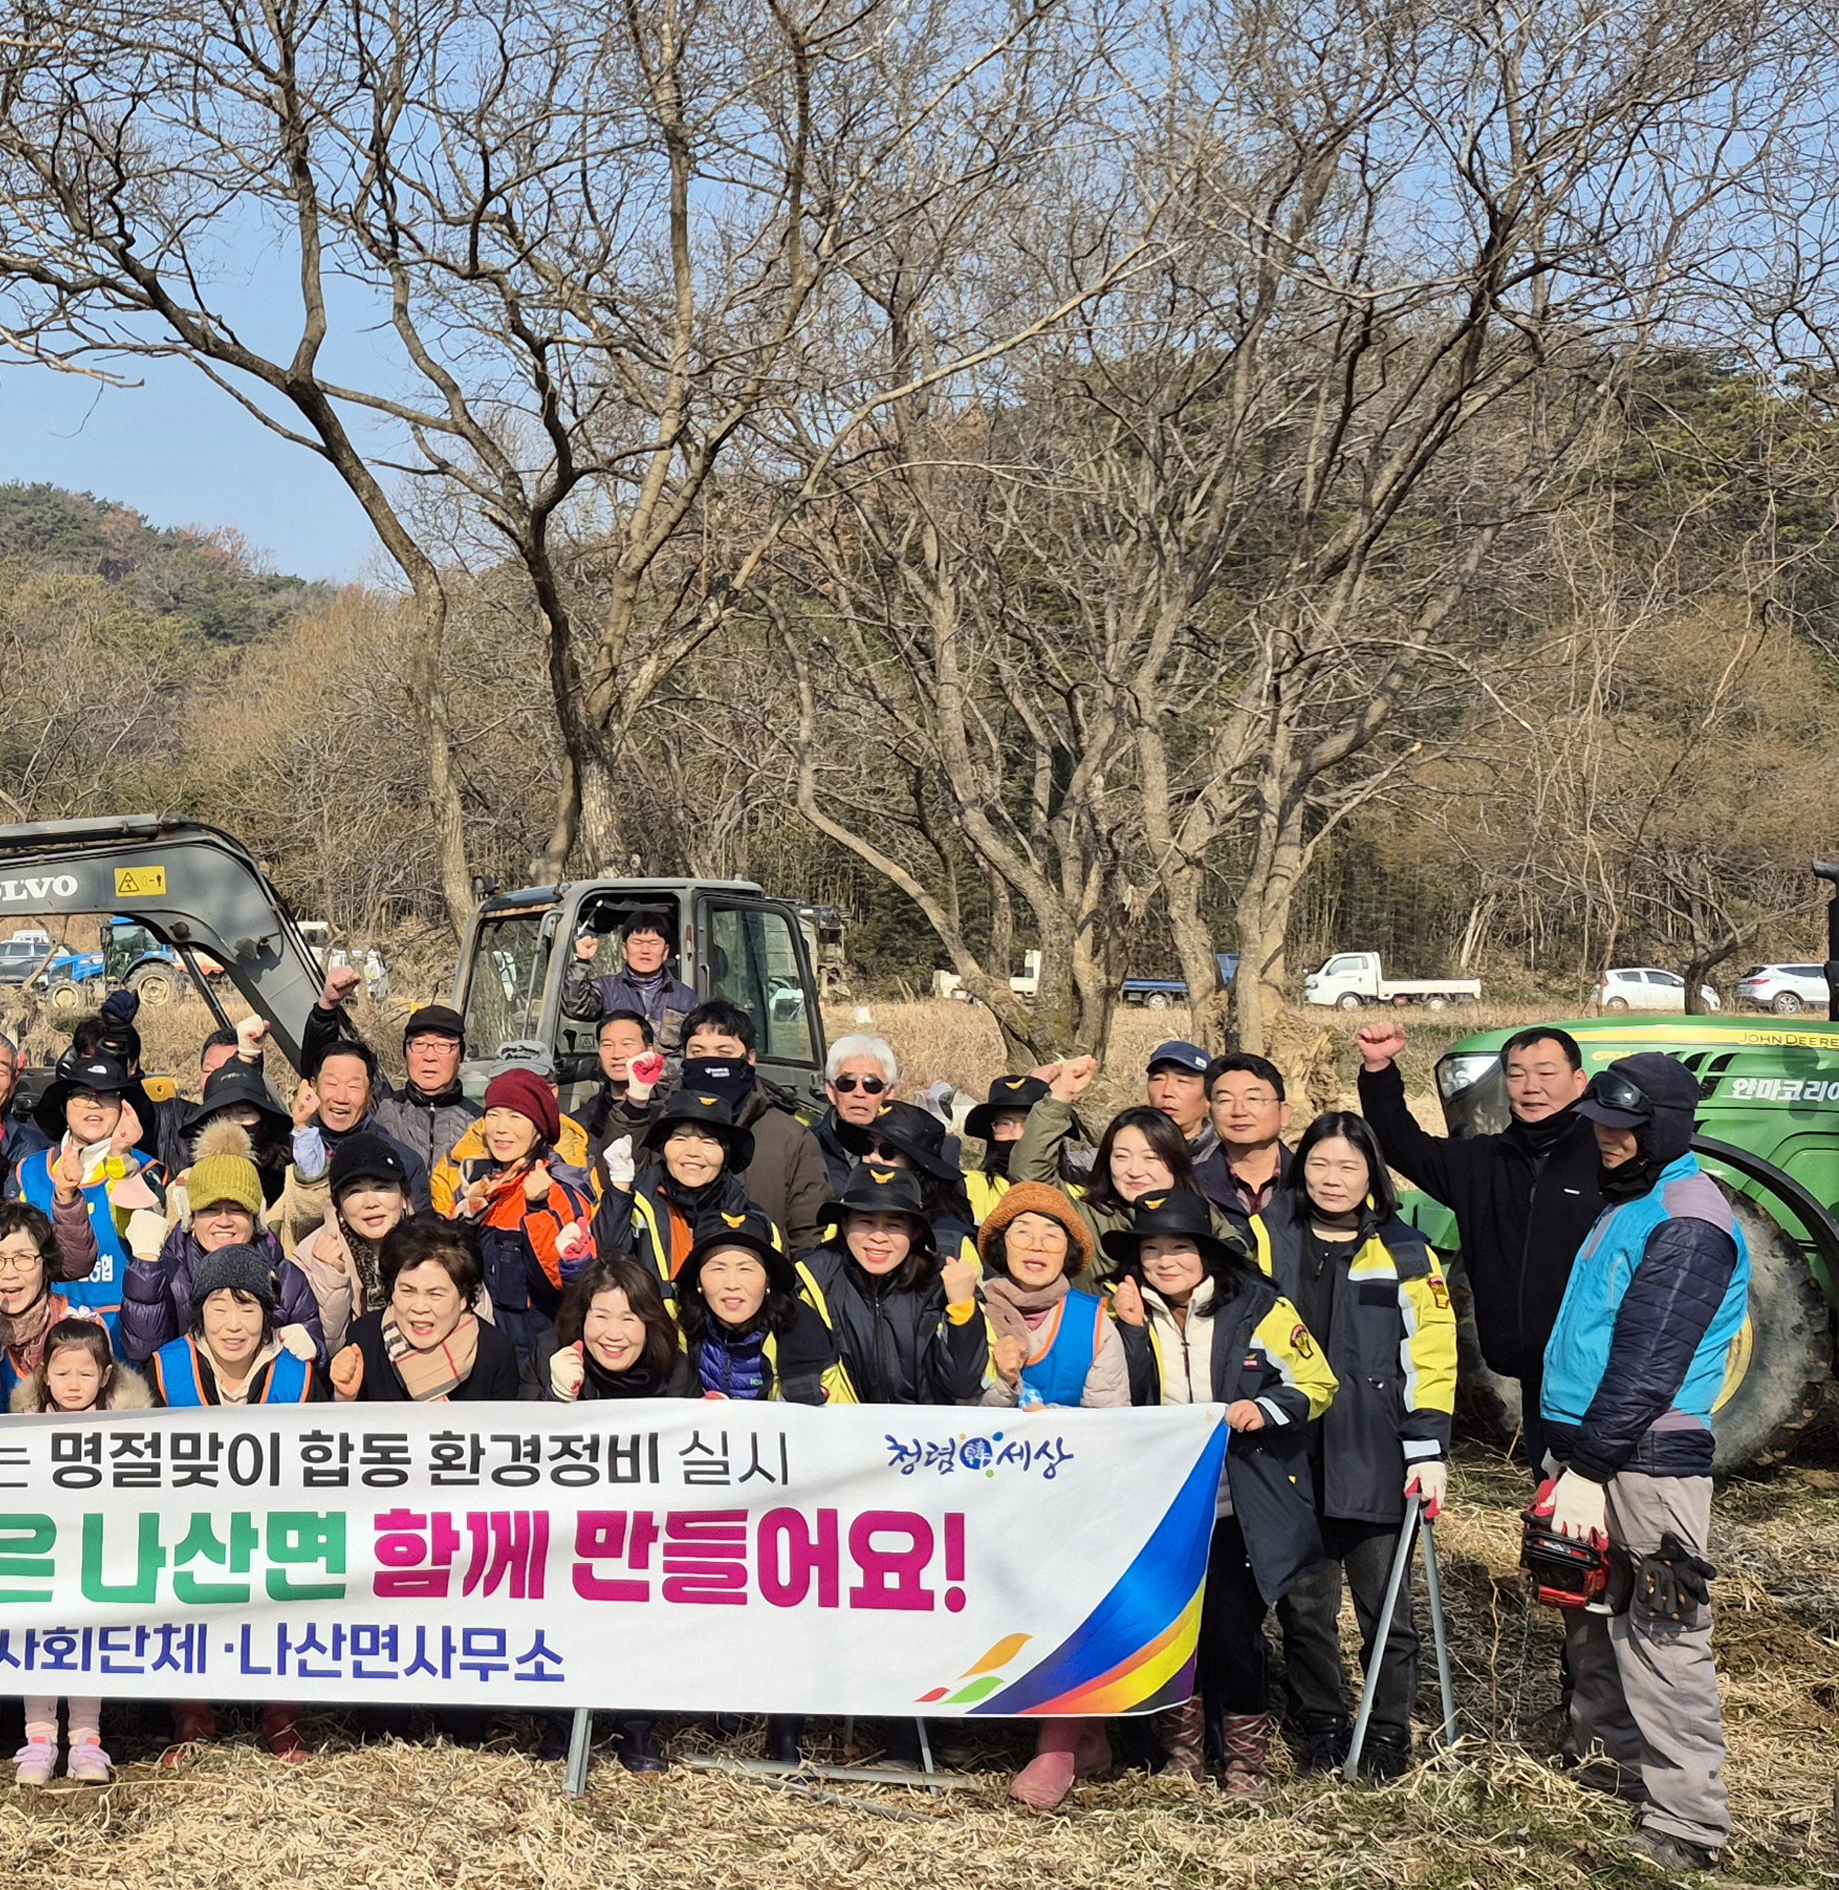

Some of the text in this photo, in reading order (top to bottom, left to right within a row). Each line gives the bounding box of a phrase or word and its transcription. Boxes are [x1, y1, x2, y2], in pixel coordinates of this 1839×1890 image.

[1739, 1032, 1839, 1047] JOHN DEERE
[77, 1253, 113, 1283] 농협
[51, 1432, 280, 1488] 명절맞이
[299, 1430, 411, 1487] 합동
[428, 1430, 660, 1487] 환경정비
[678, 1430, 789, 1486] 실시
[81, 1511, 347, 1604] 나산면
[372, 1508, 550, 1600] 함께
[572, 1507, 967, 1613] 만들어요!
